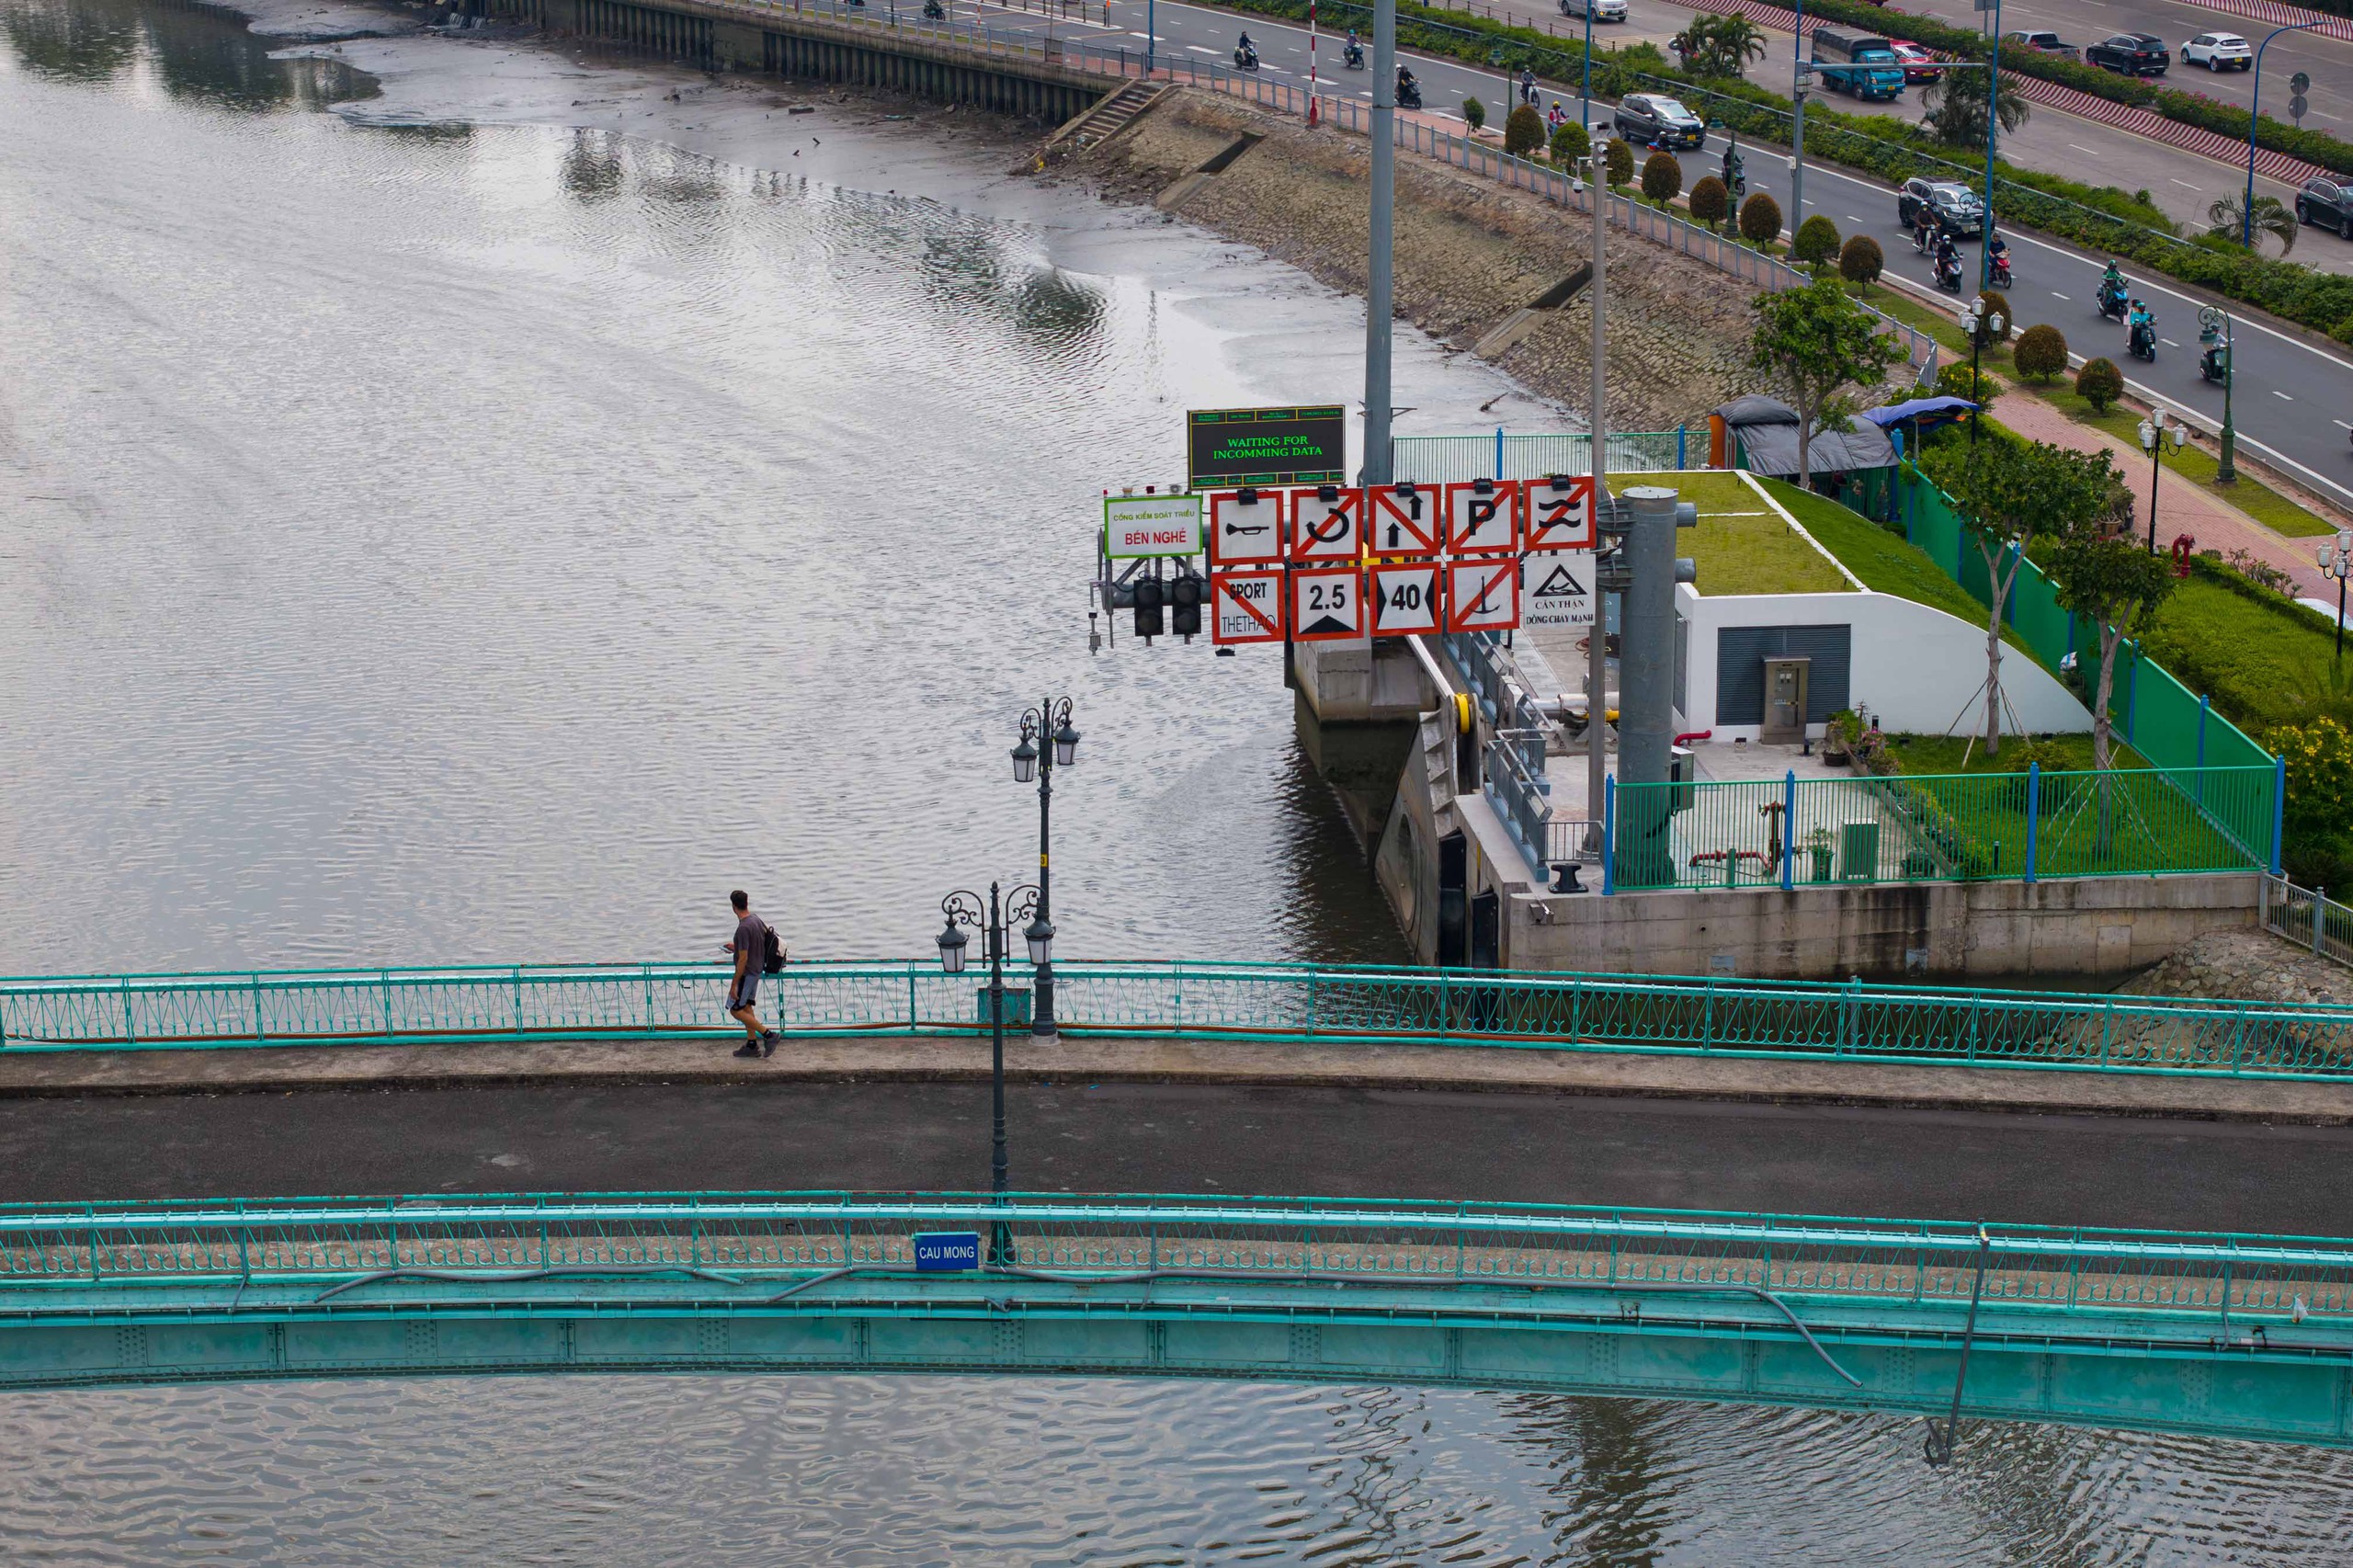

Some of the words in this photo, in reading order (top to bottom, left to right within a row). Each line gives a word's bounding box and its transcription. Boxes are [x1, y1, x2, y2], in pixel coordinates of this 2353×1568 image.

[1227, 437, 1280, 448] WAITING
[1283, 436, 1309, 446] FOR
[1213, 448, 1289, 460] INCOMMING
[1291, 446, 1323, 457] DATA
[1468, 499, 1496, 536] P
[1229, 582, 1267, 600] SPORT
[1309, 584, 1346, 611] 2.5
[1391, 584, 1421, 611] 40
[919, 1246, 941, 1259] CAU
[943, 1245, 975, 1259] MONG
